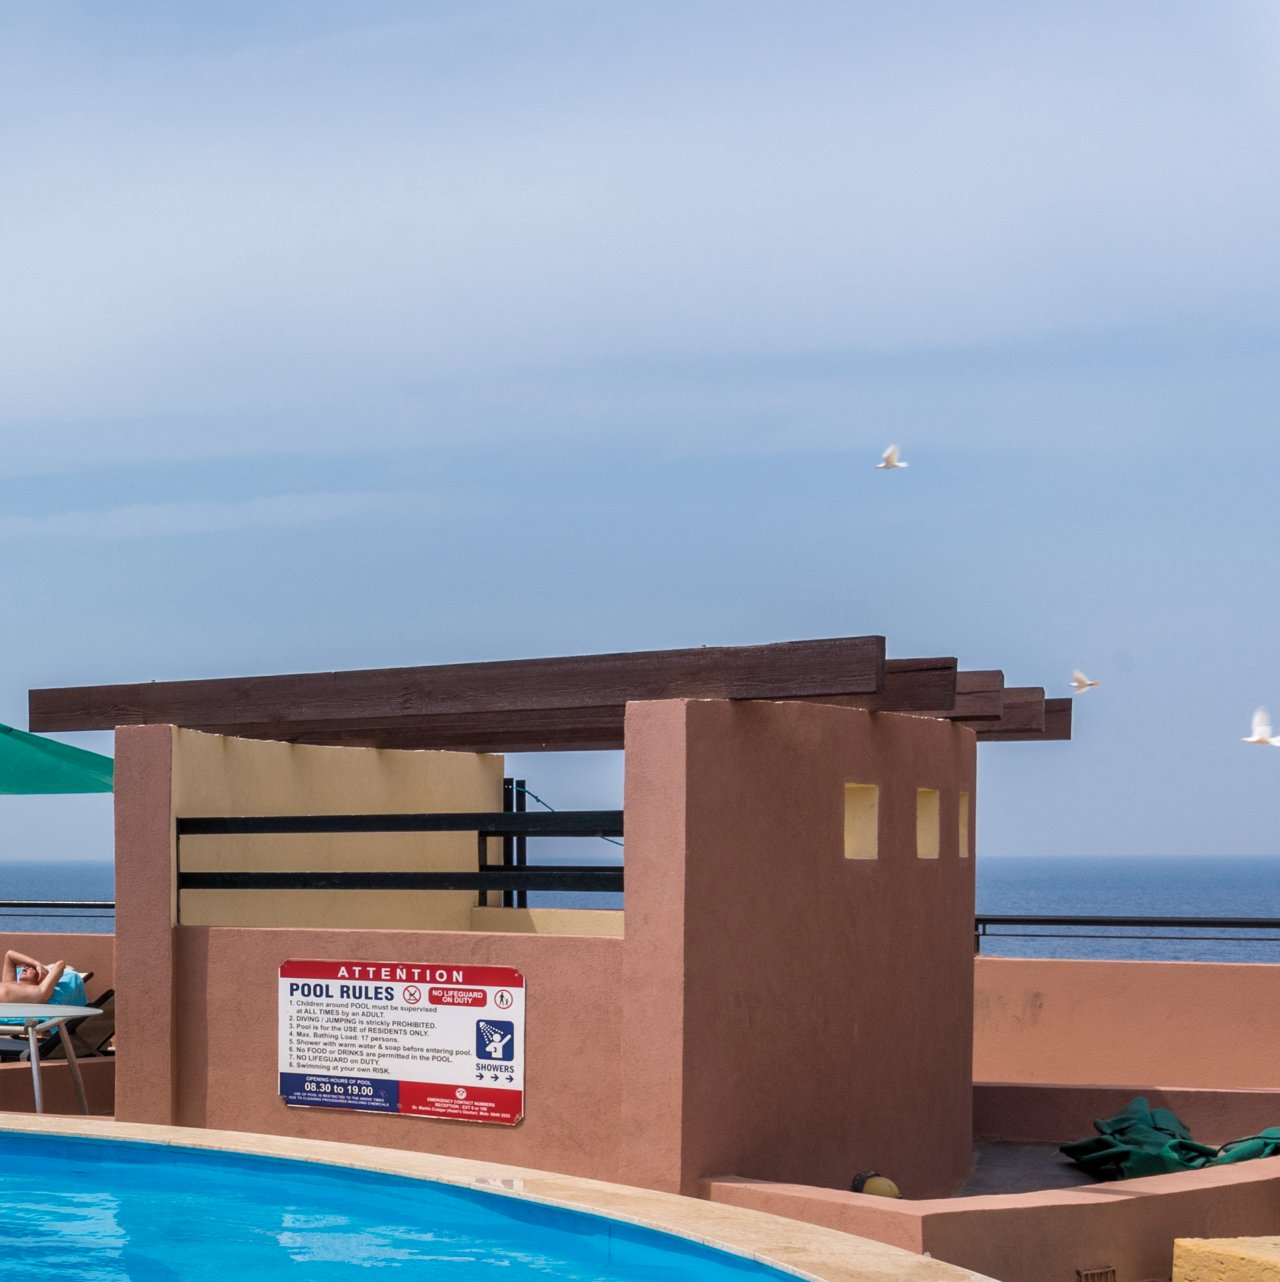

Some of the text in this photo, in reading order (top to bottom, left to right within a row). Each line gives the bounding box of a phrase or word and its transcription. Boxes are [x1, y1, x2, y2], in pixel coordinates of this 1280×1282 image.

[337, 966, 463, 982] ATTENTION
[290, 983, 394, 1001] POOL RULES
[378, 1052, 409, 1060] permitted
[432, 1055, 453, 1063] POOL.
[297, 1063, 330, 1071] Swimming
[476, 1063, 514, 1073] SHOWERS
[305, 1082, 373, 1095] 08.30 to 19.00
